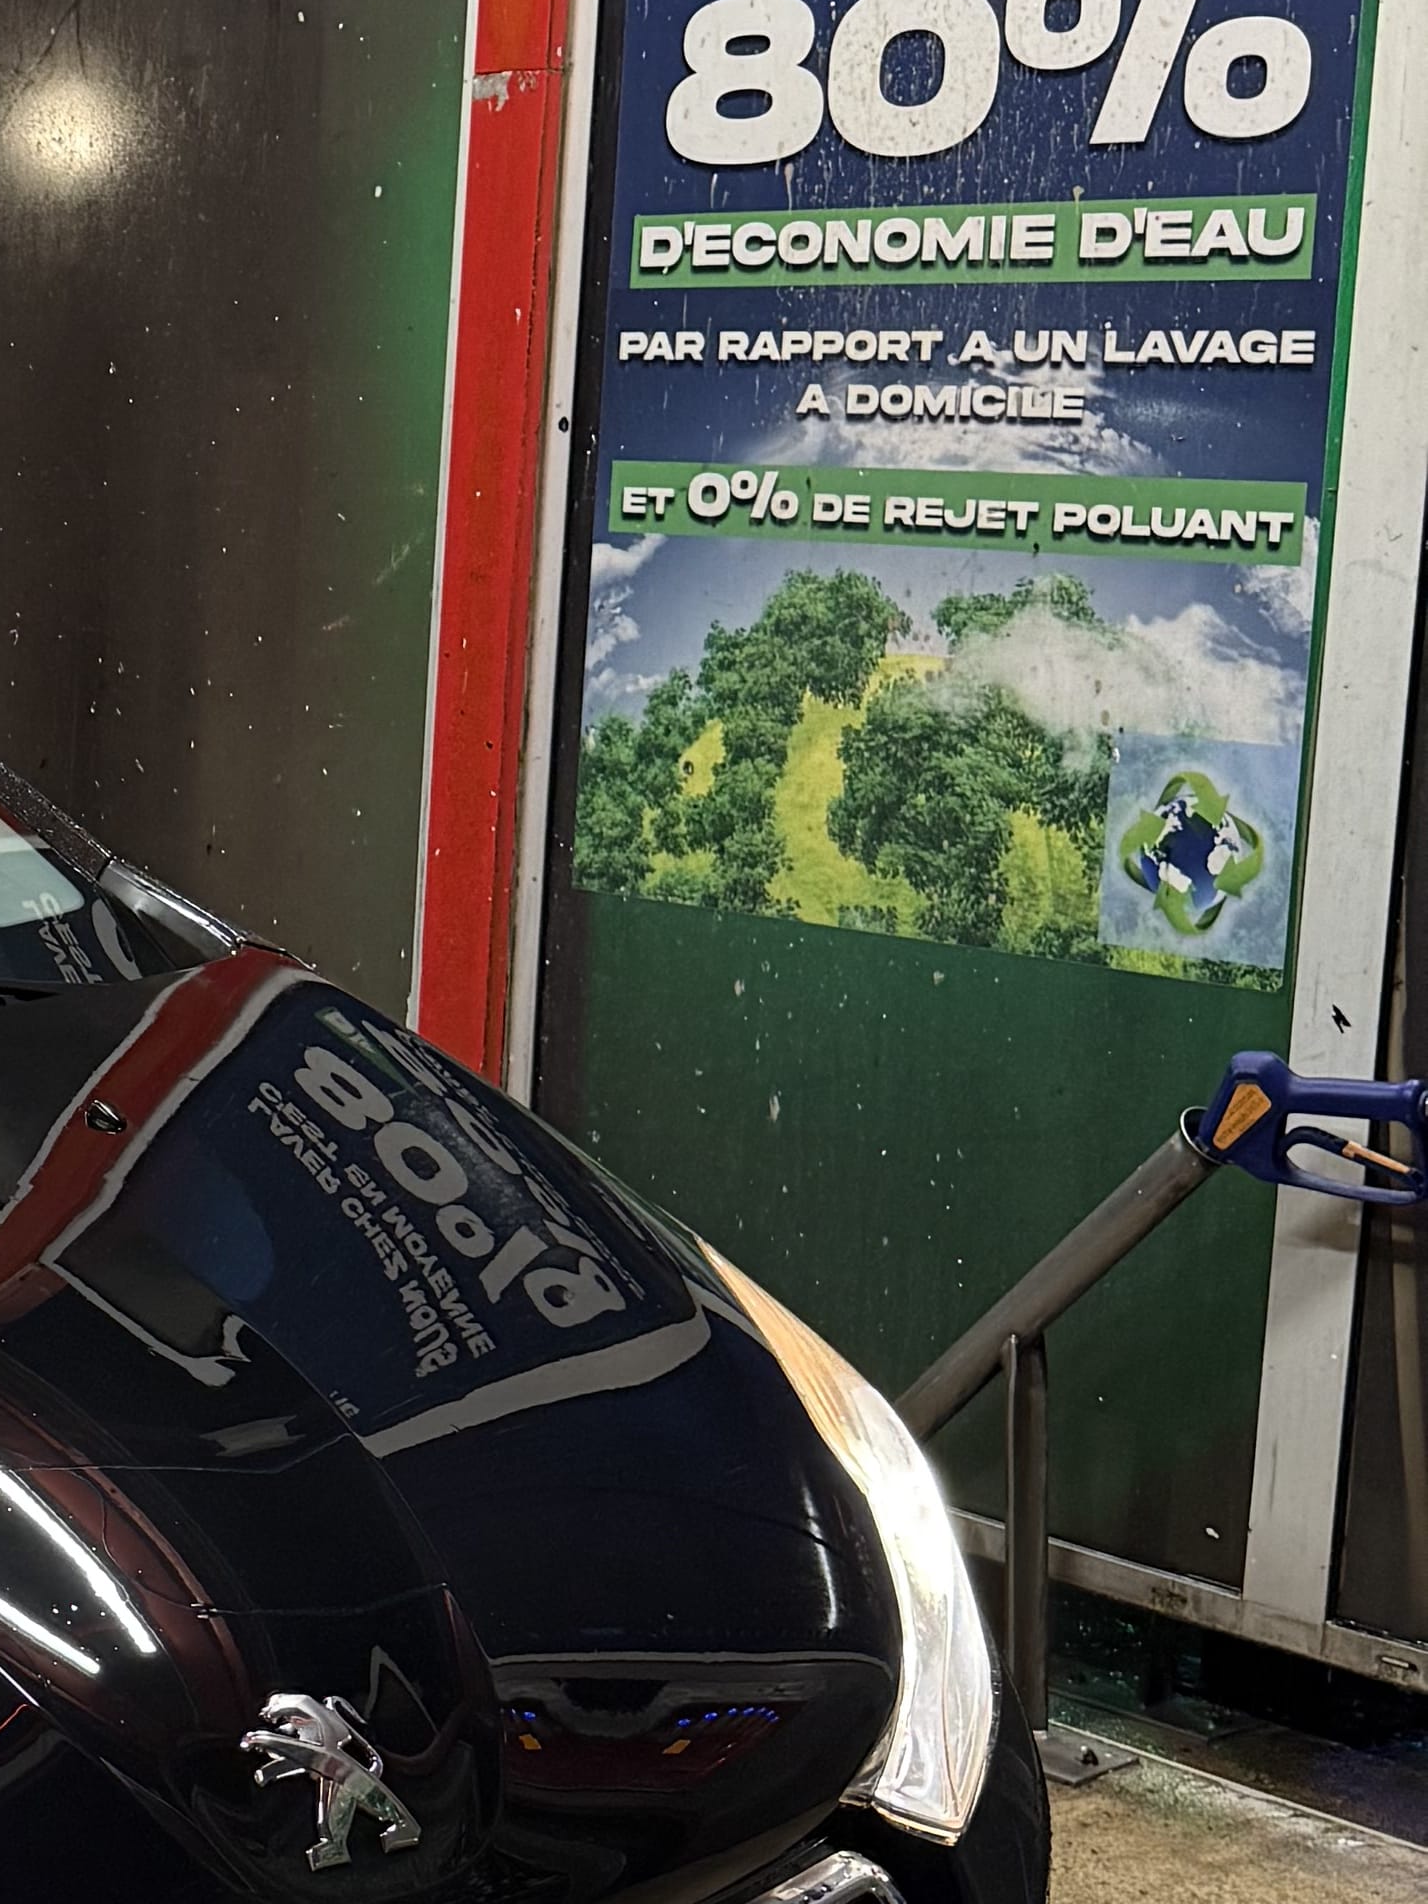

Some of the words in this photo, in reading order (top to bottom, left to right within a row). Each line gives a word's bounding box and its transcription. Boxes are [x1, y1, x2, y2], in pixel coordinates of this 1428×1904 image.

[639, 213, 1056, 269] D'ECONOMIE
[1078, 206, 1306, 259] D'EAU
[619, 330, 706, 362] PAR
[718, 330, 944, 363] RAPPORT
[958, 329, 996, 364] A
[1013, 329, 1088, 363] UN
[1103, 329, 1316, 365] LAVAGE
[795, 383, 831, 415] A
[846, 383, 1086, 419] DOMICILE
[621, 486, 675, 515] ET
[687, 470, 800, 520] 0%
[812, 492, 871, 524] DE
[883, 496, 1040, 531] REJET
[1052, 502, 1295, 543] POLUANT
